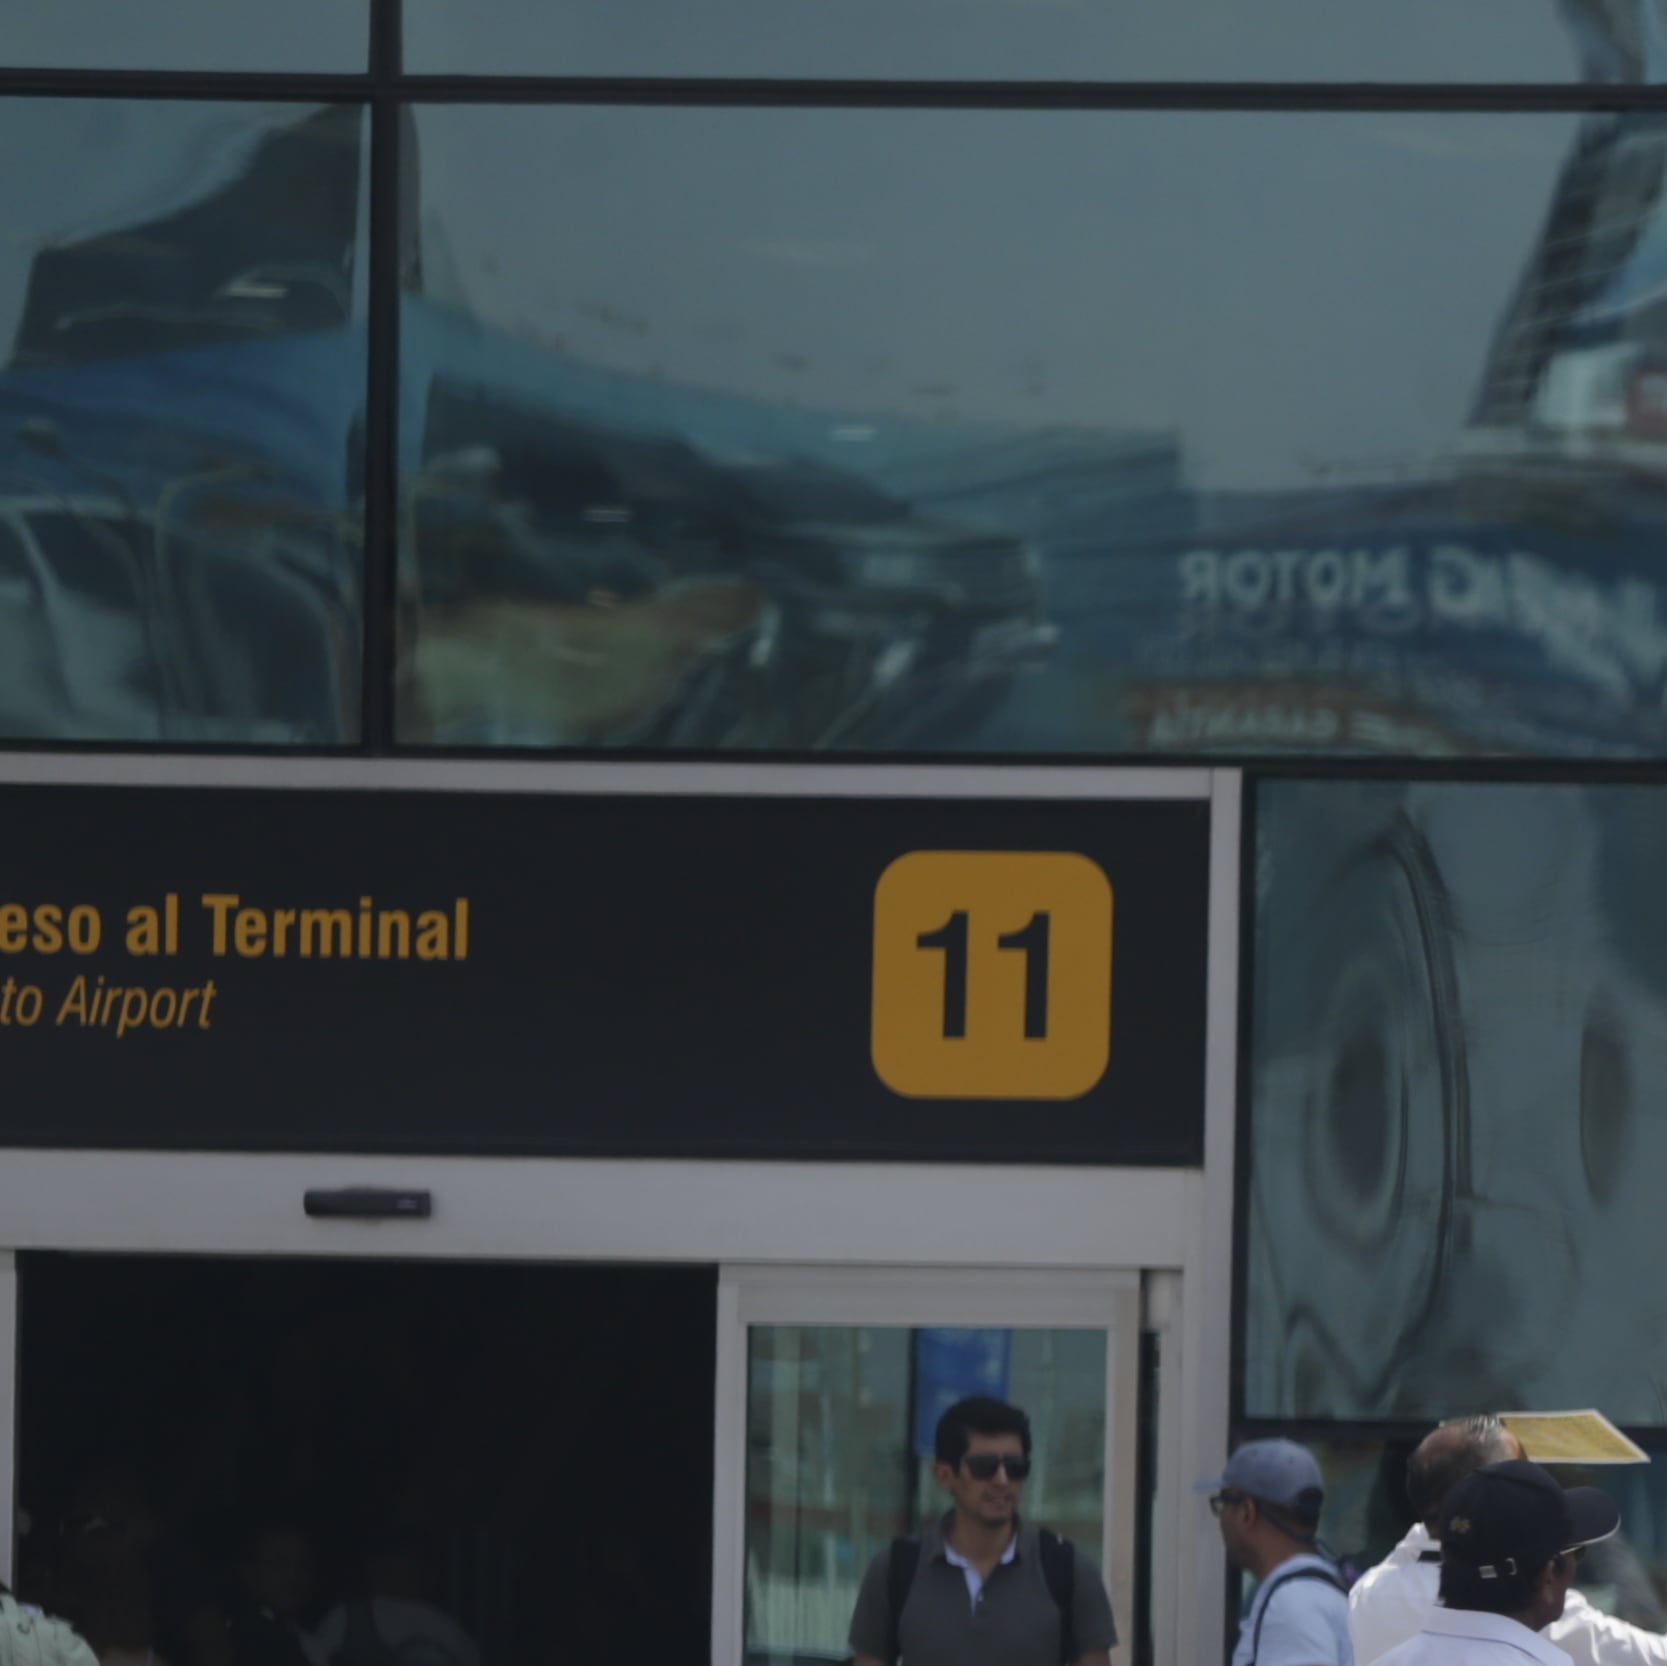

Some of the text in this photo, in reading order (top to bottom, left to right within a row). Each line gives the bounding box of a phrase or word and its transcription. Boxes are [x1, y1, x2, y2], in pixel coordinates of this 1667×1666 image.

[125, 893, 179, 956] al
[201, 893, 470, 960] Terminal
[0, 974, 217, 1040] to Airport
[915, 909, 1051, 1042] 11
